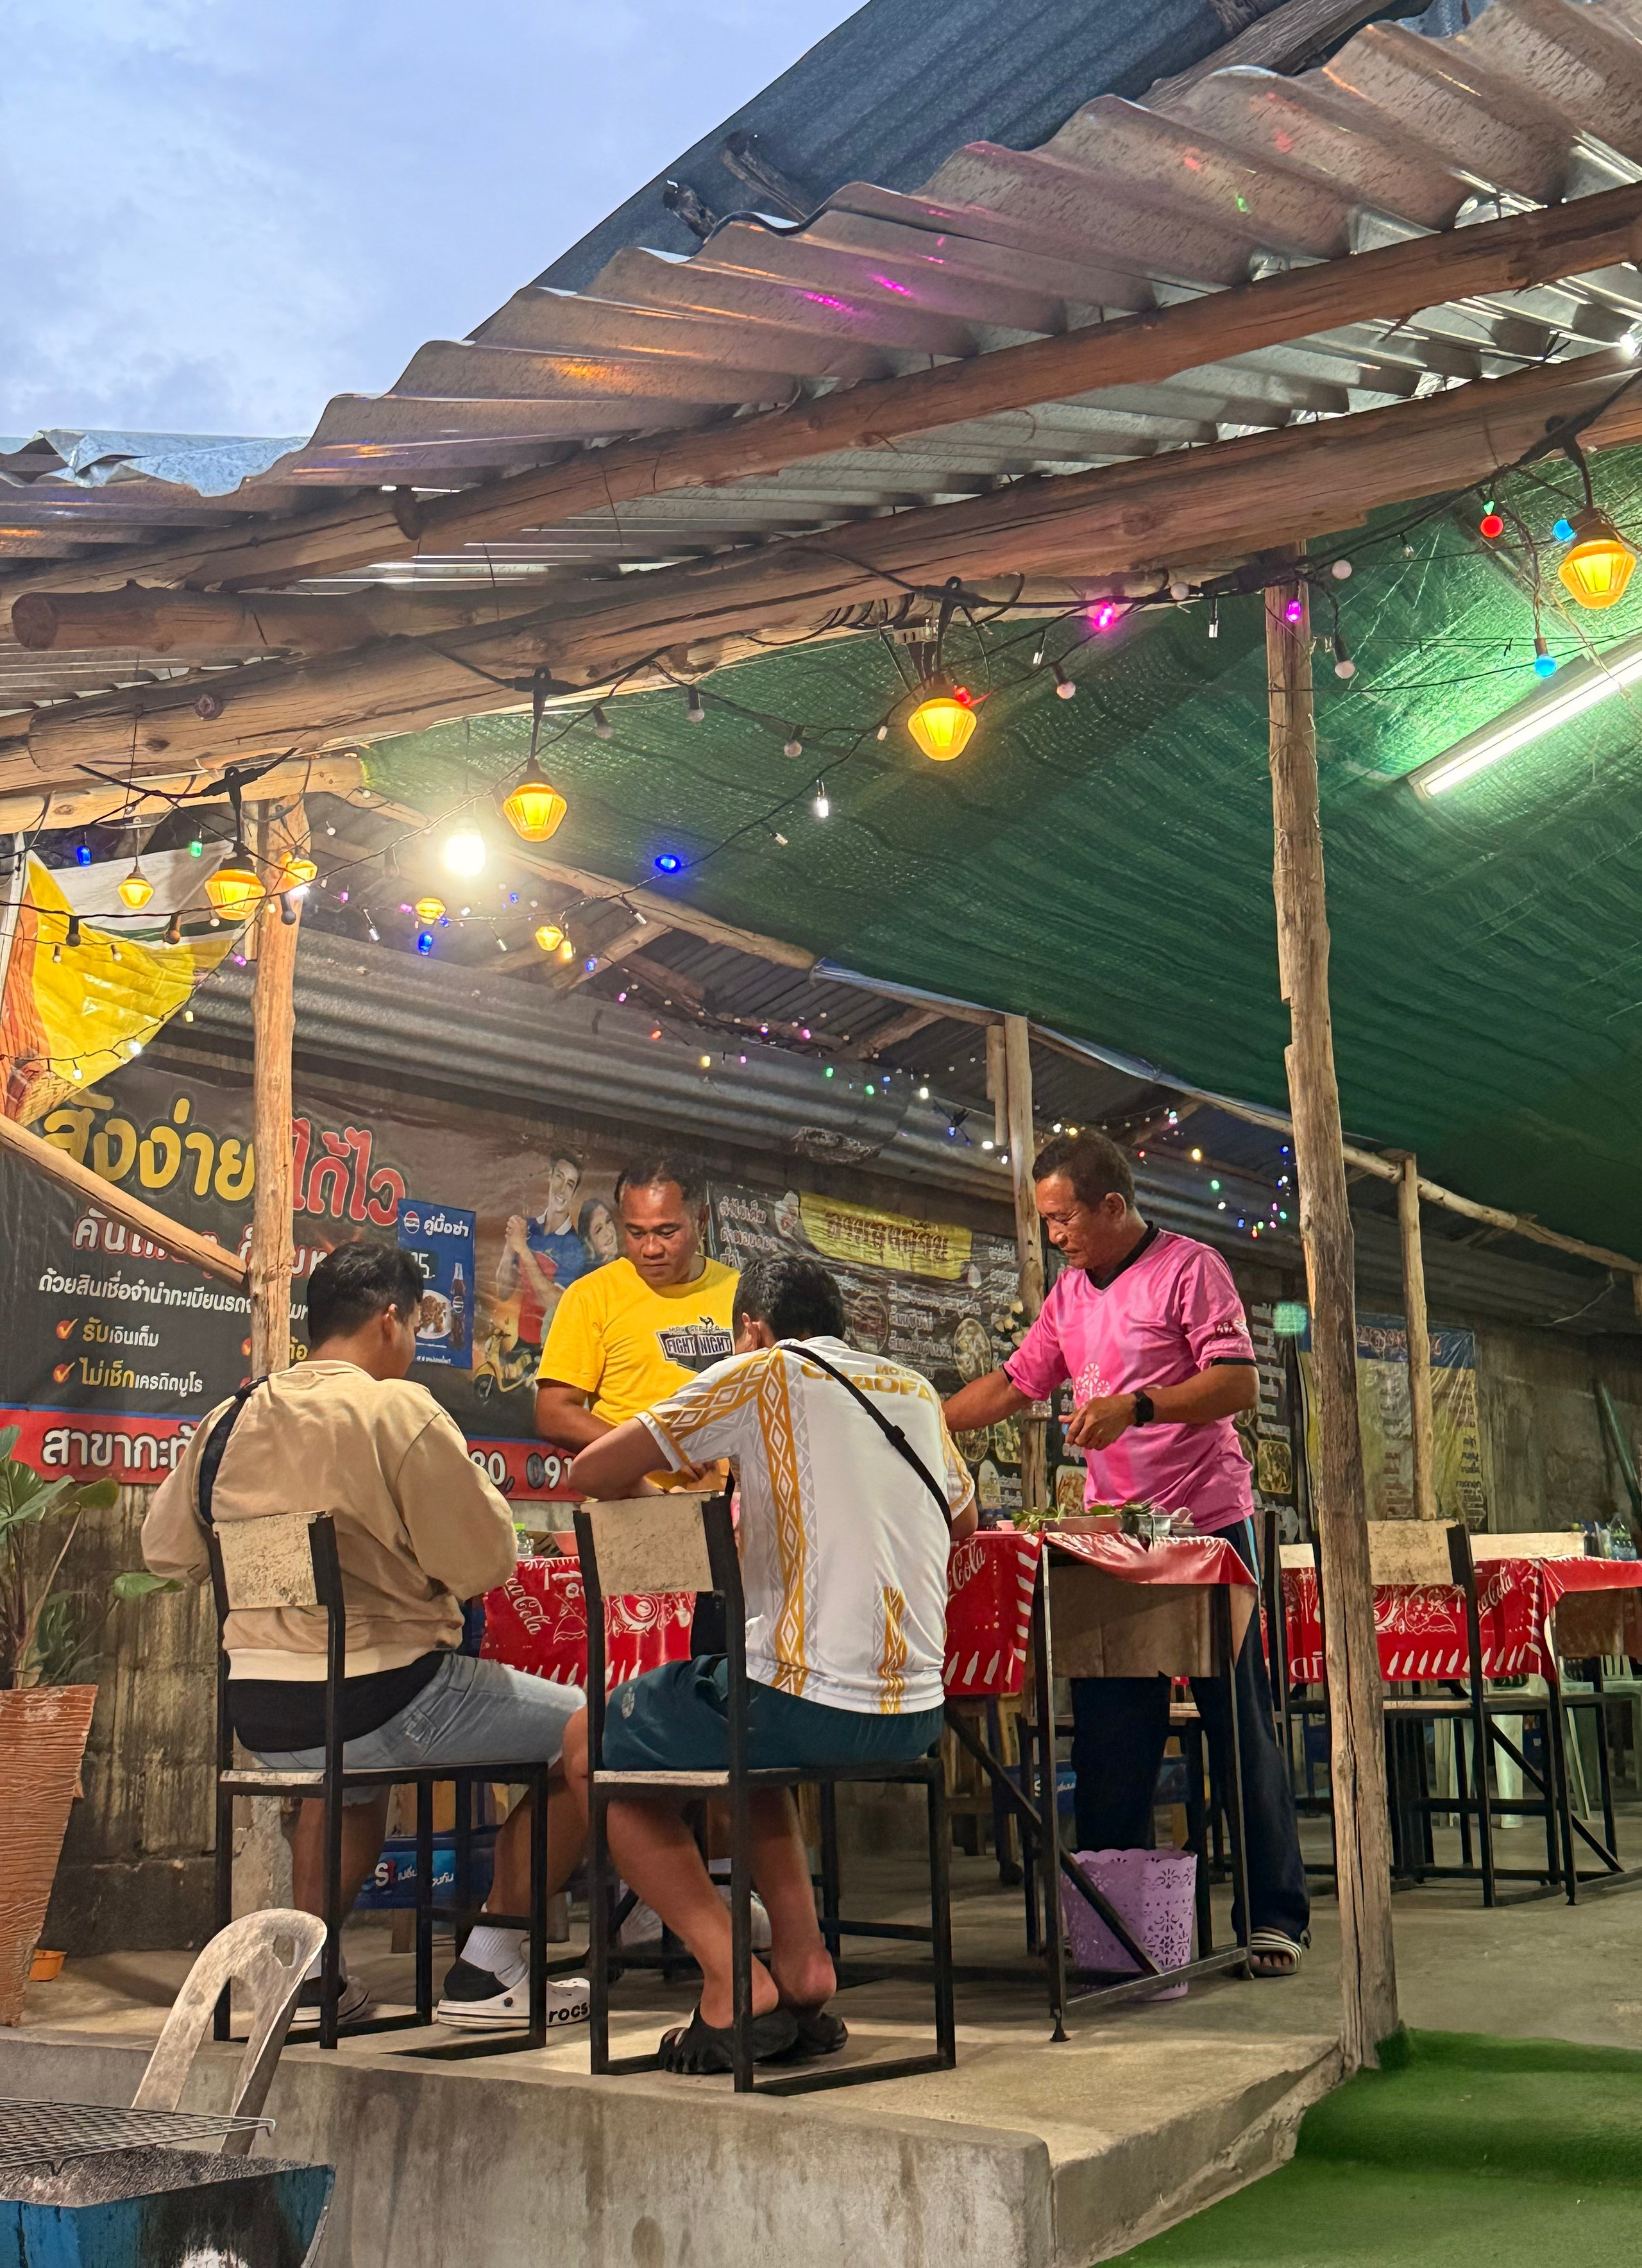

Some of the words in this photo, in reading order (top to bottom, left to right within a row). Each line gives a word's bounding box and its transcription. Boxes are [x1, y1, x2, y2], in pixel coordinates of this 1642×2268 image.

[666, 1336, 695, 1354] FIGHT
[700, 1335, 731, 1354] NIGHT
[548, 2002, 588, 2023] rocs
